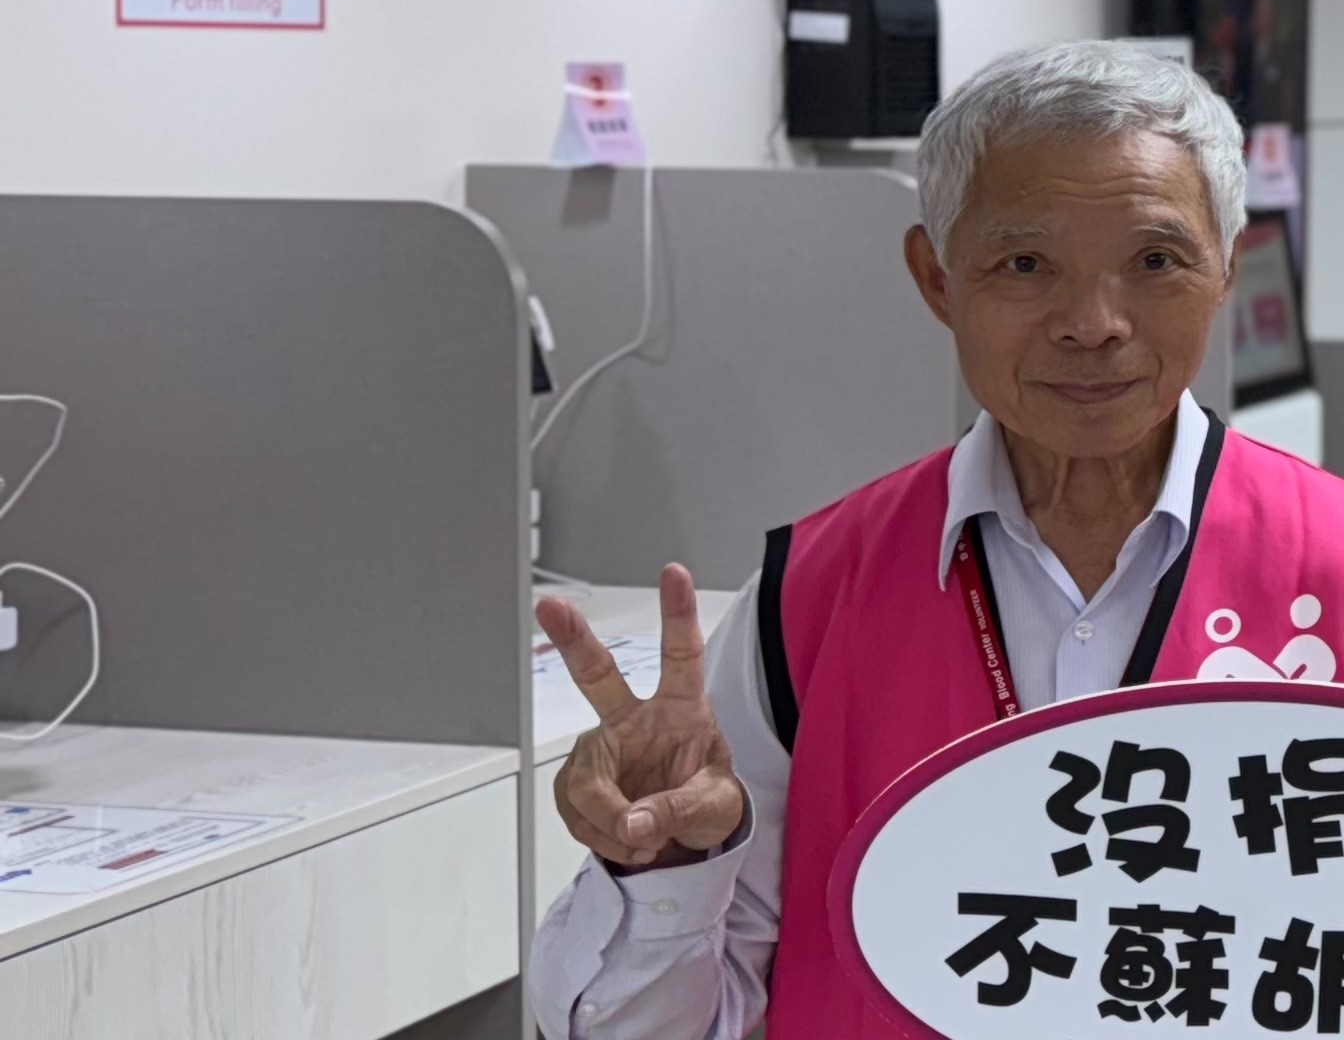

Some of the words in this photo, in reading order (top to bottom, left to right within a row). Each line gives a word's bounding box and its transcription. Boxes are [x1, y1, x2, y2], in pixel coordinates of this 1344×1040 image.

[969, 589, 987, 631] VOLUNTEER
[981, 633, 999, 669] Center
[990, 670, 1010, 701] Blood
